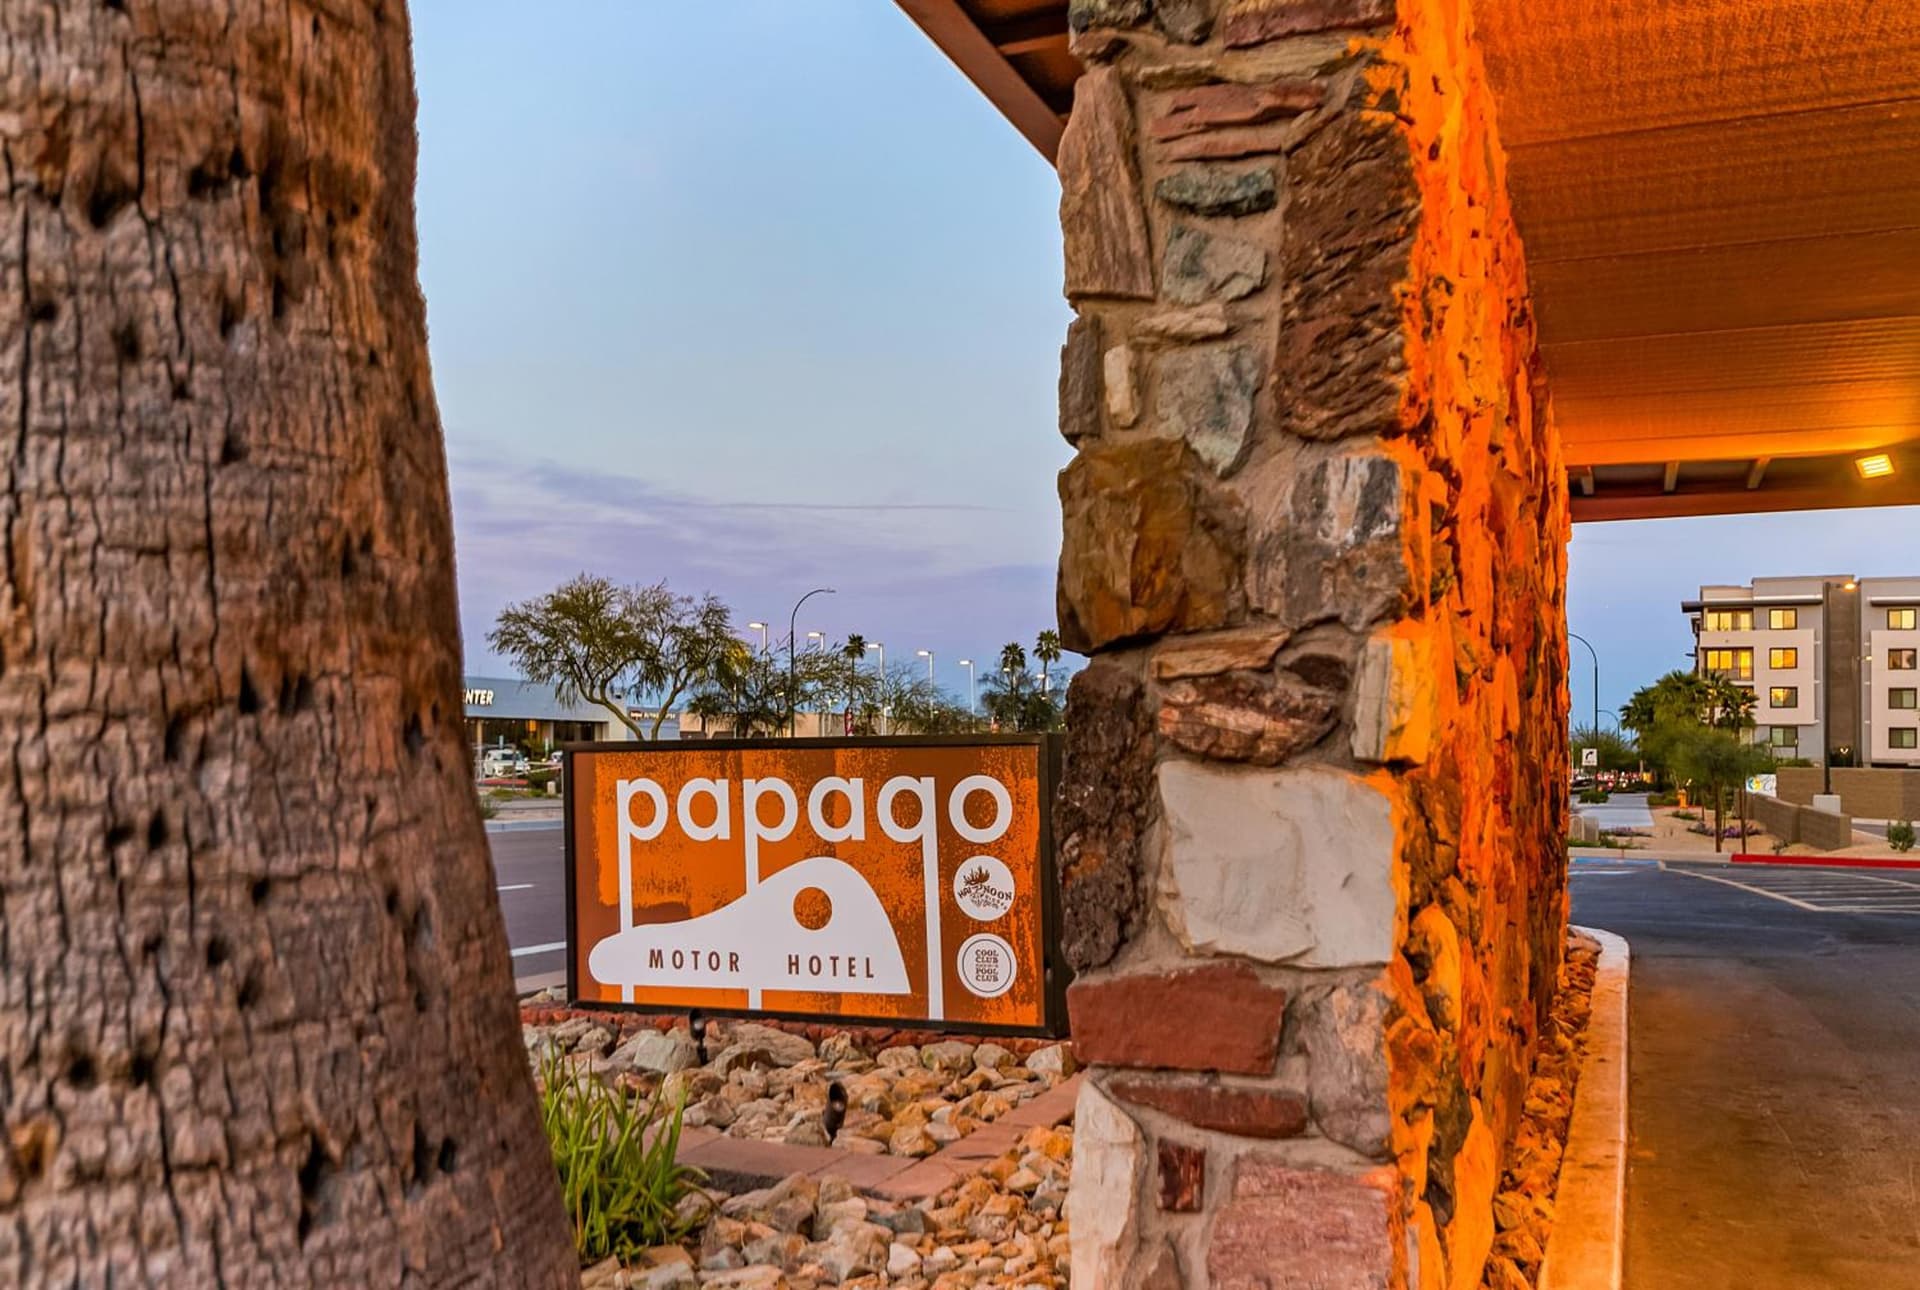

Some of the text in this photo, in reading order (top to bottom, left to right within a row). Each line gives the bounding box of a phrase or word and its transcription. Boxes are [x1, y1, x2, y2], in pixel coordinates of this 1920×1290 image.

[983, 885, 1012, 901] NOON
[975, 949, 999, 957] COOL
[649, 949, 875, 979] MOTOR HOTEL
[975, 956, 999, 964] CLUB
[975, 967, 999, 975] POOL
[975, 974, 999, 982] CLUB
